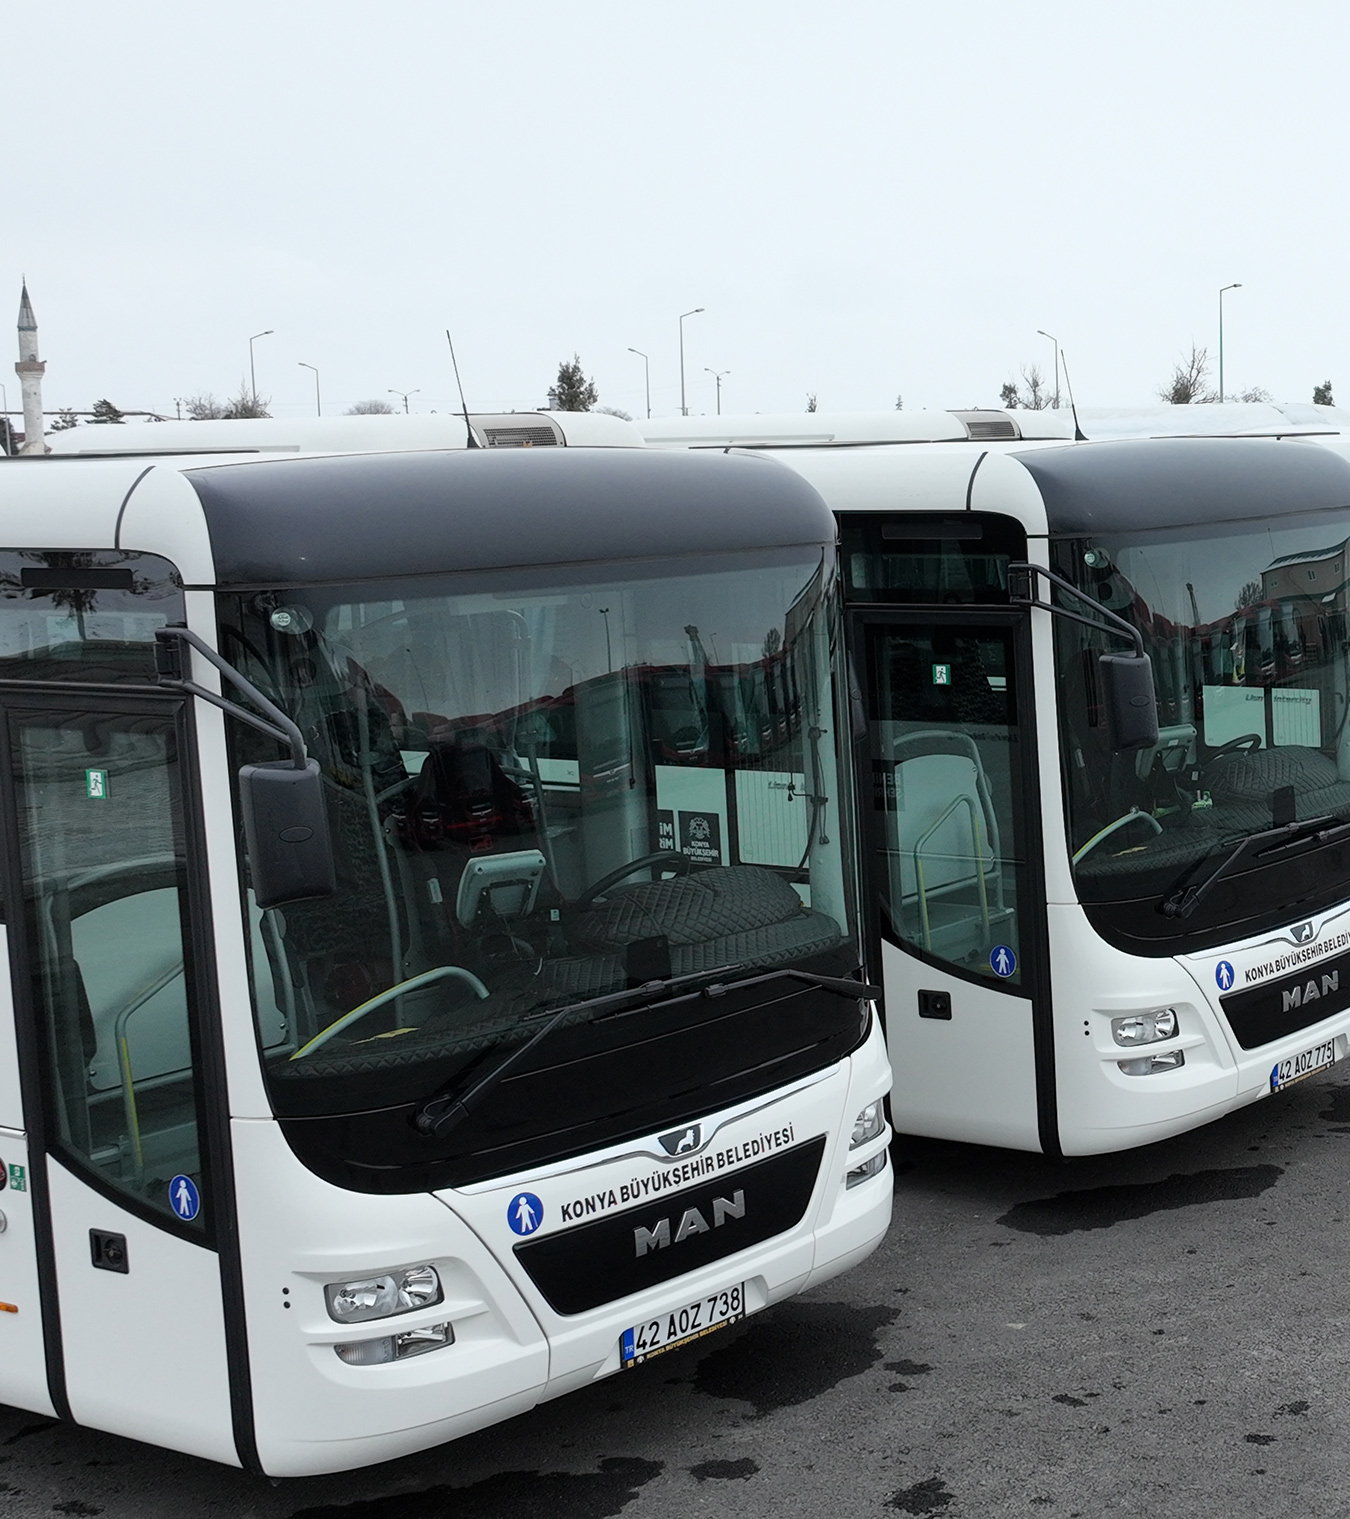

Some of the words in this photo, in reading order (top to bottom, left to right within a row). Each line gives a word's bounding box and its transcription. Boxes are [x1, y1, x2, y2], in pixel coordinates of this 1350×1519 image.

[691, 840, 710, 848] KONYA
[1244, 962, 1275, 983] KONYA
[1276, 942, 1324, 972] BÜYÜKŞEHİR
[1281, 969, 1340, 1013] MAN
[1279, 1060, 1292, 1081] 42
[1294, 1050, 1313, 1075] AOZ
[1315, 1041, 1332, 1066] 775
[560, 1189, 618, 1223] KONYA
[619, 1155, 715, 1203] BÜYÜKŞEHİR
[717, 1121, 795, 1170] BELEDİYESİ
[633, 1188, 747, 1258] MAN
[635, 1321, 660, 1351] 42
[666, 1302, 702, 1340] AOZ
[707, 1287, 741, 1323] 738
[624, 1345, 634, 1354] TR
